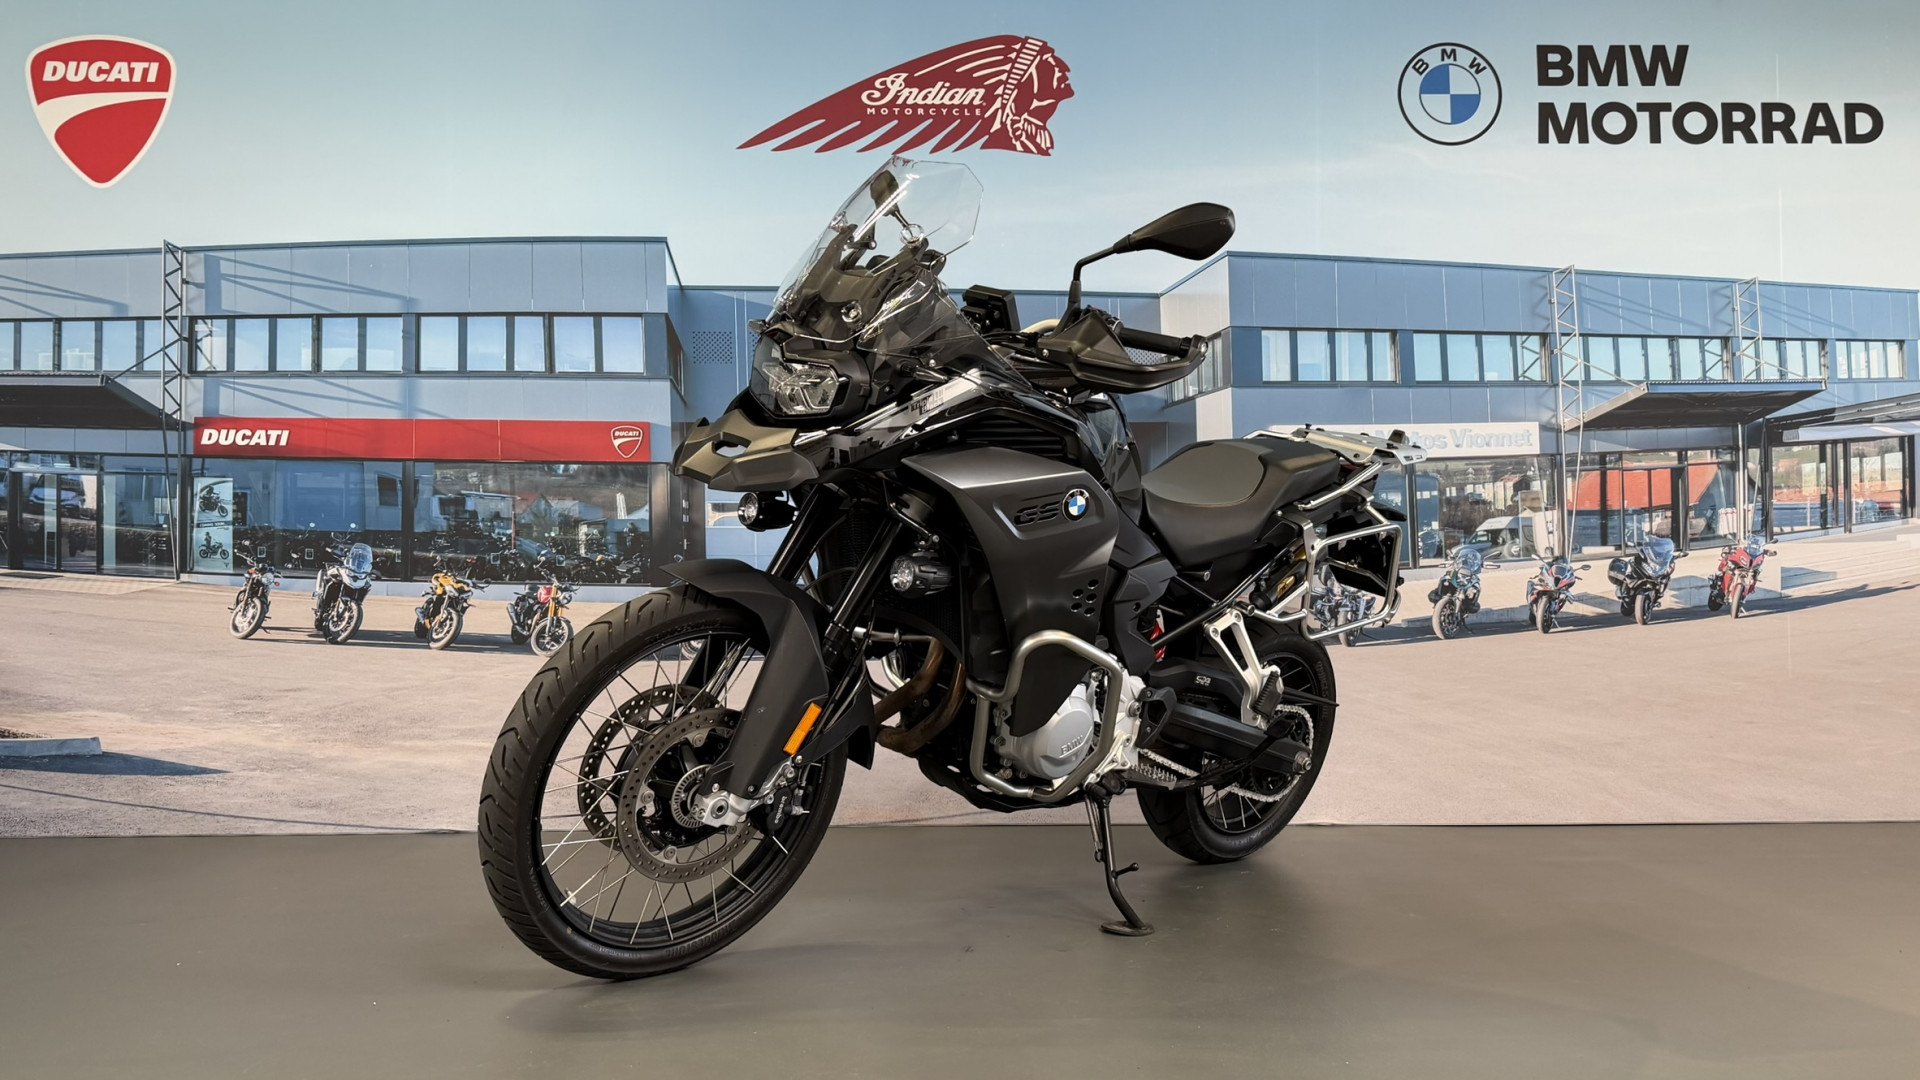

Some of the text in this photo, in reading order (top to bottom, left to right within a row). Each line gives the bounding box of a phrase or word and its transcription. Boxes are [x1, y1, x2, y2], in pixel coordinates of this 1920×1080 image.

[42, 60, 159, 82] DUCATI
[1411, 47, 1487, 76] BMW
[1536, 44, 1689, 87] BMW
[861, 72, 985, 106] Indian
[866, 107, 981, 116] MOTORCYCLE
[1538, 101, 1884, 145] MOTORRAD
[200, 428, 290, 447] DUCATI
[1449, 428, 1533, 449] Vionnet
[1014, 500, 1060, 526] GS
